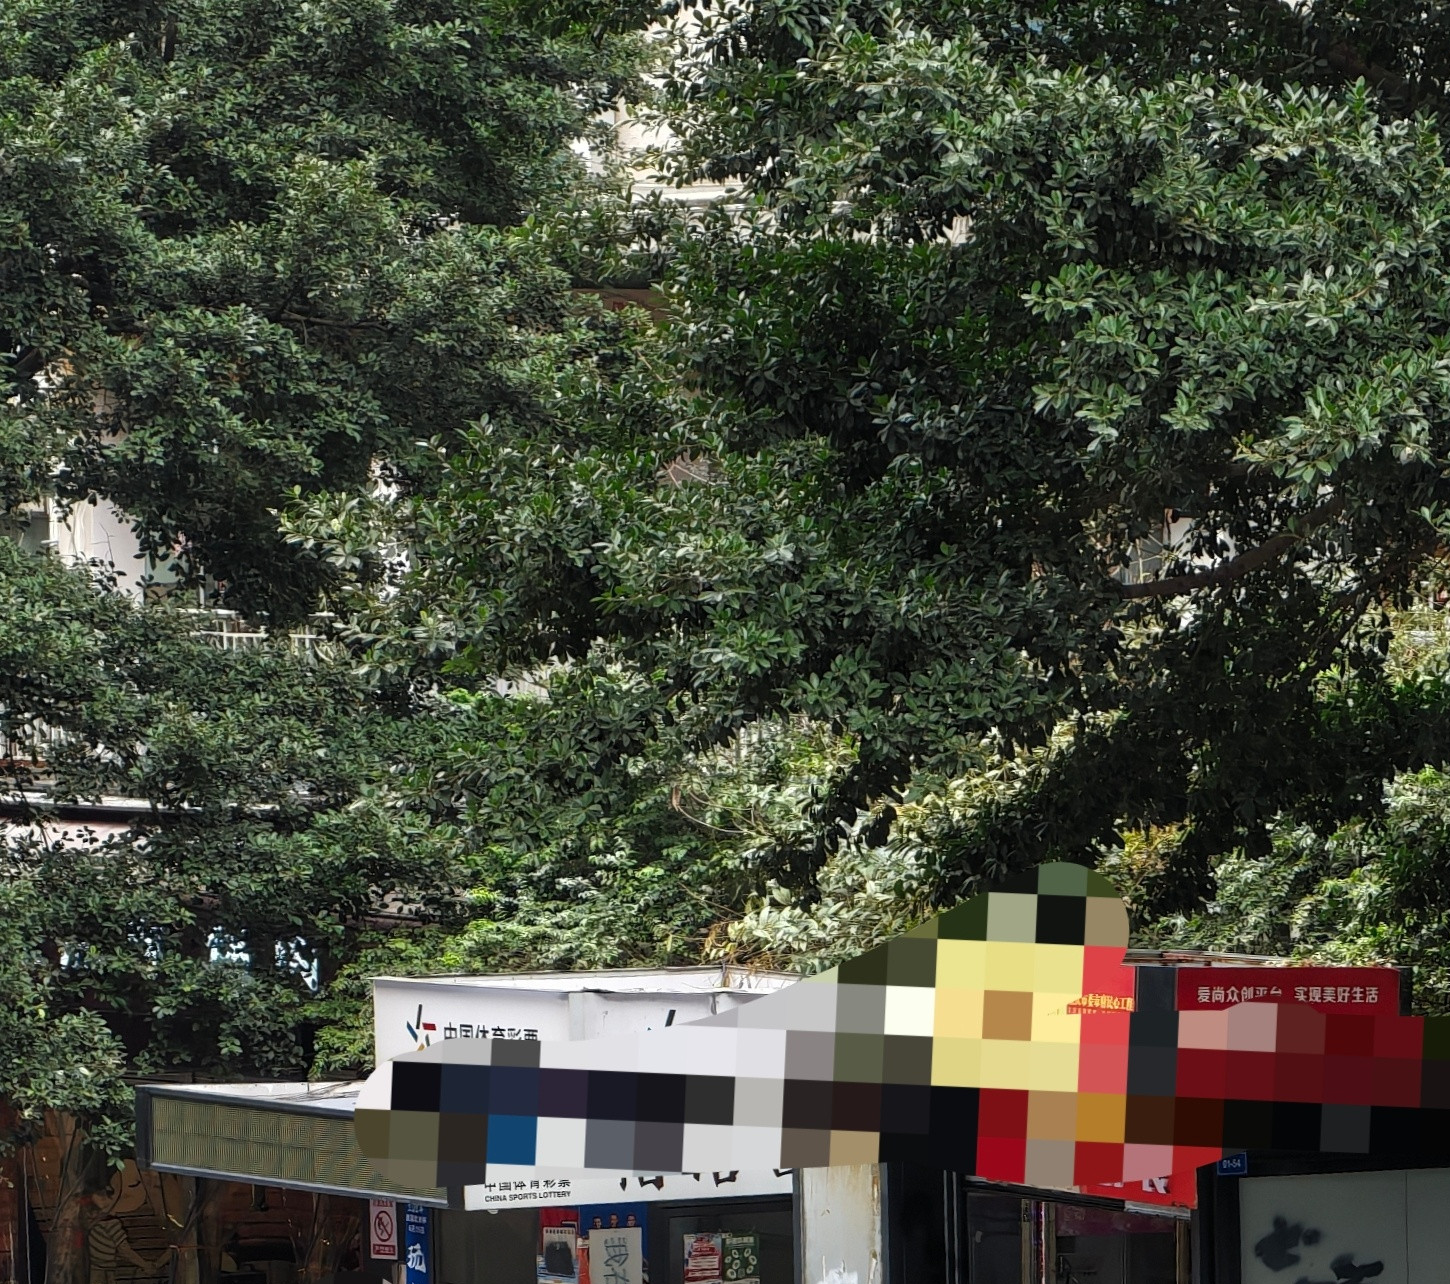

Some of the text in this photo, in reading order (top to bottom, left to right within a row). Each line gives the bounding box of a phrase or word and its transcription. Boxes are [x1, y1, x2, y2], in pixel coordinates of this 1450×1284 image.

[1294, 986, 1379, 1003] 实现美好生活
[485, 1190, 572, 1203] CHINA SPORTS LOTTERY
